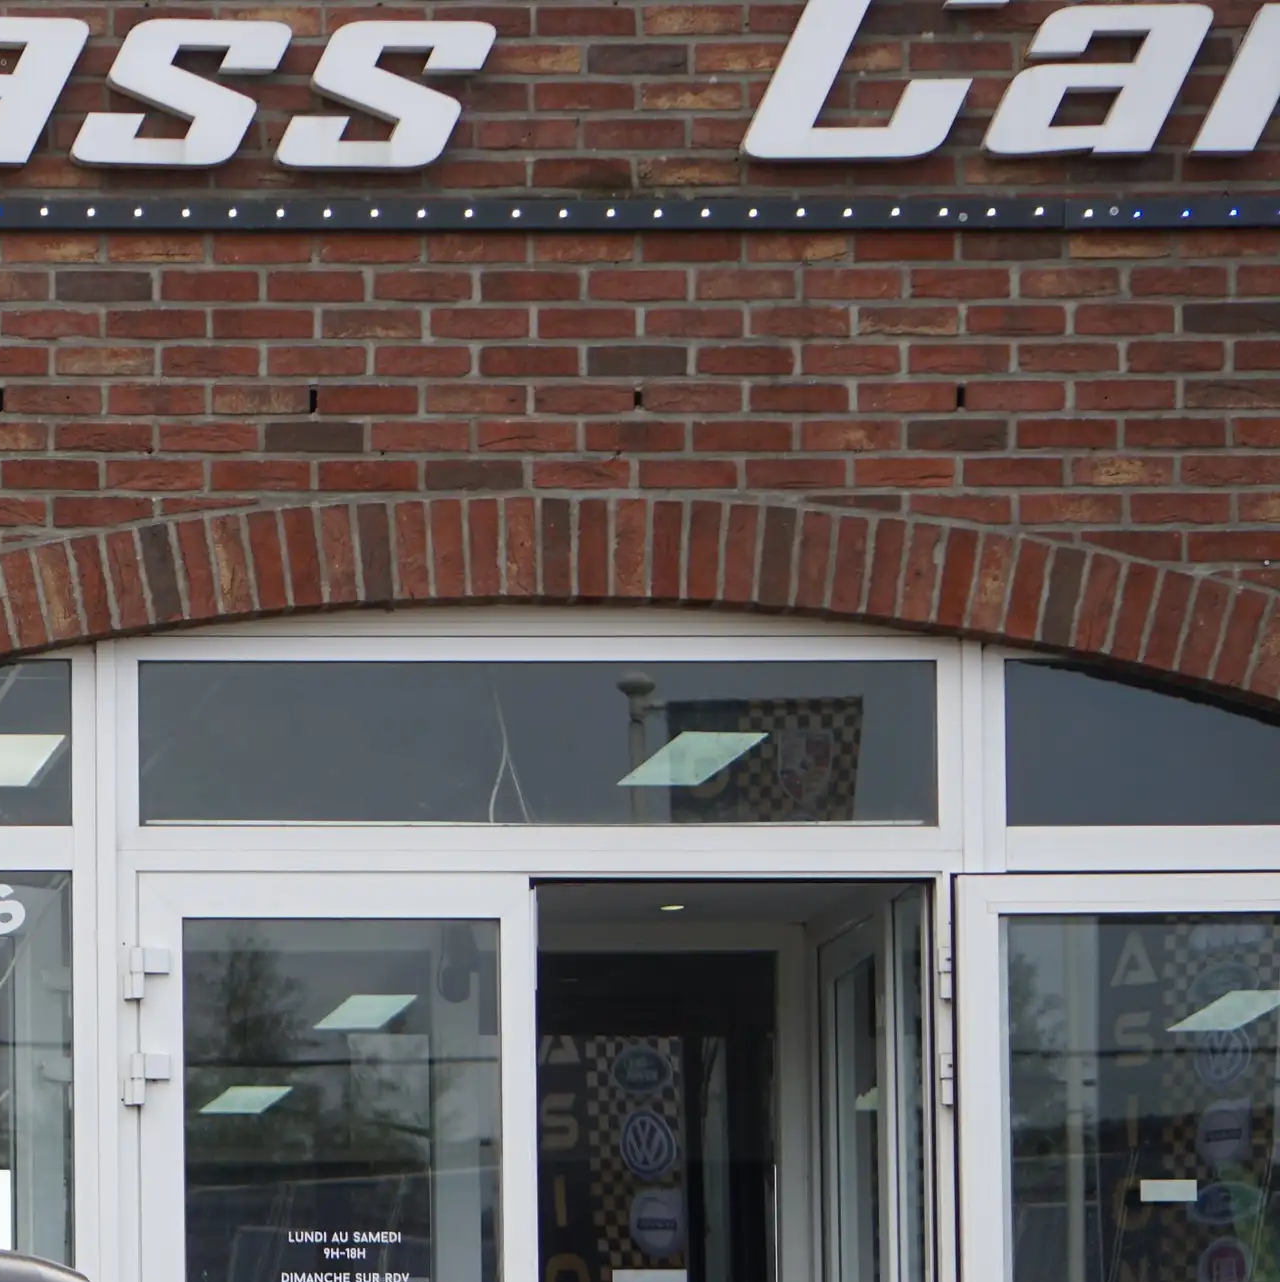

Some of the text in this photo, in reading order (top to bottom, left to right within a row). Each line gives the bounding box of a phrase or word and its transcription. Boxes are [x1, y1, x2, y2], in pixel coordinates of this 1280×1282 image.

[287, 1231, 403, 1243] LUNDI AU SAMEDI
[323, 1247, 367, 1259] 9H-18H
